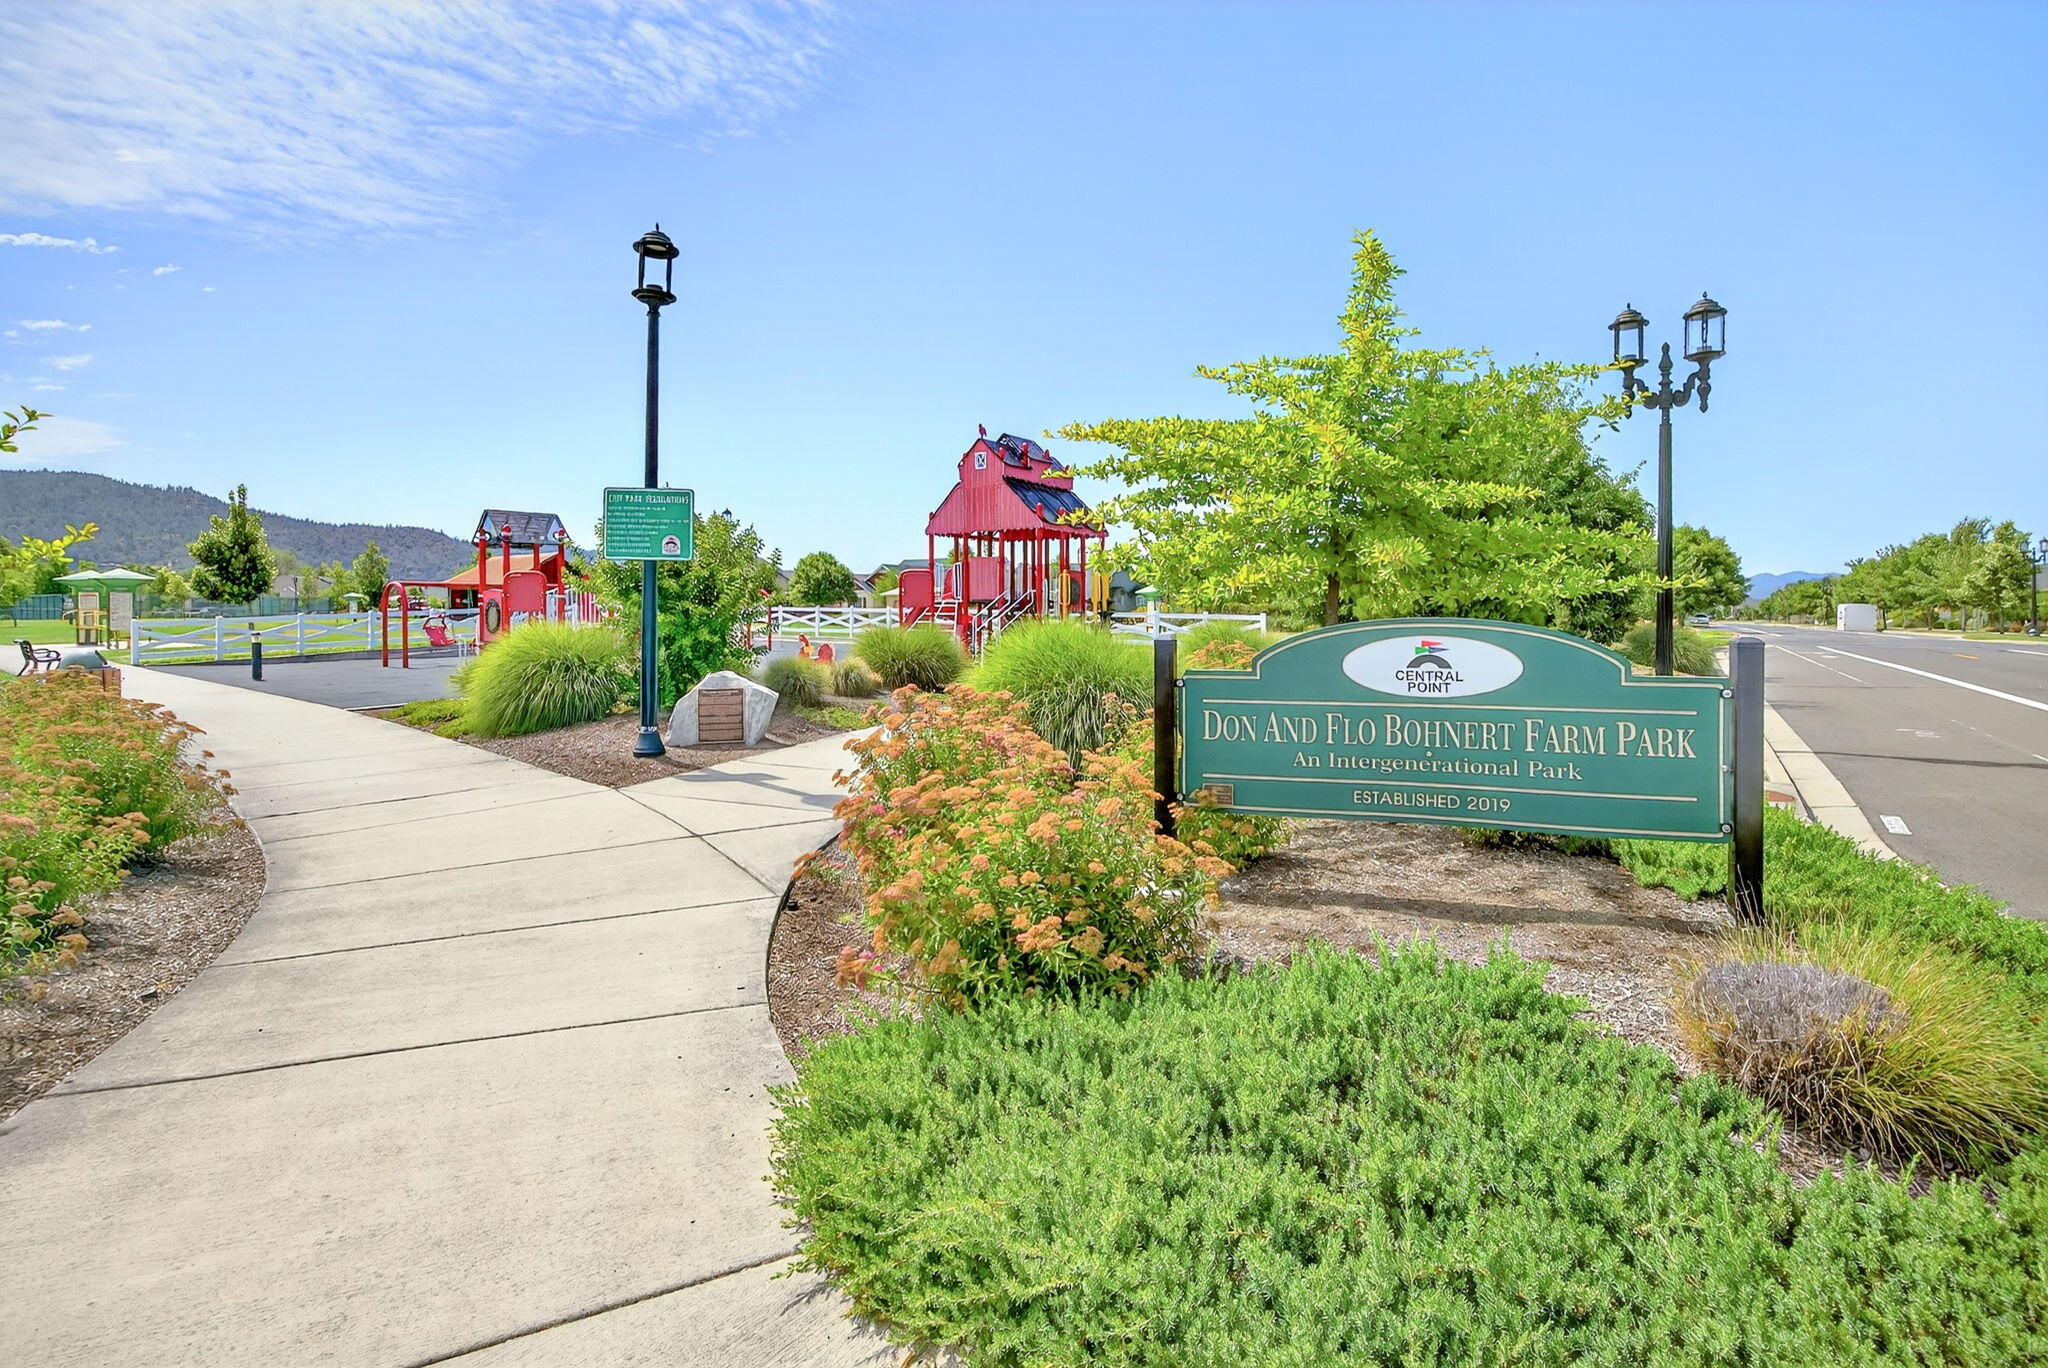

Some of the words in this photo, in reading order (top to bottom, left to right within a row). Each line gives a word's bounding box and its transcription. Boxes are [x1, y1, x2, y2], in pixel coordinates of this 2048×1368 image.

[1395, 670, 1464, 682] CENTRAL
[1407, 682, 1451, 693] POINT
[1202, 709, 1257, 743] DON
[1263, 711, 1318, 744] AND
[1325, 712, 1377, 746] FLO
[1384, 713, 1516, 751] BOHNERT
[1523, 718, 1607, 756] FARM
[1615, 721, 1697, 759] PARK
[1293, 751, 1320, 768] An
[1328, 752, 1518, 777] Intergenerational
[1528, 760, 1583, 780] Park
[1353, 790, 1461, 810] ESTABLISHED
[1467, 796, 1511, 813] 2019
